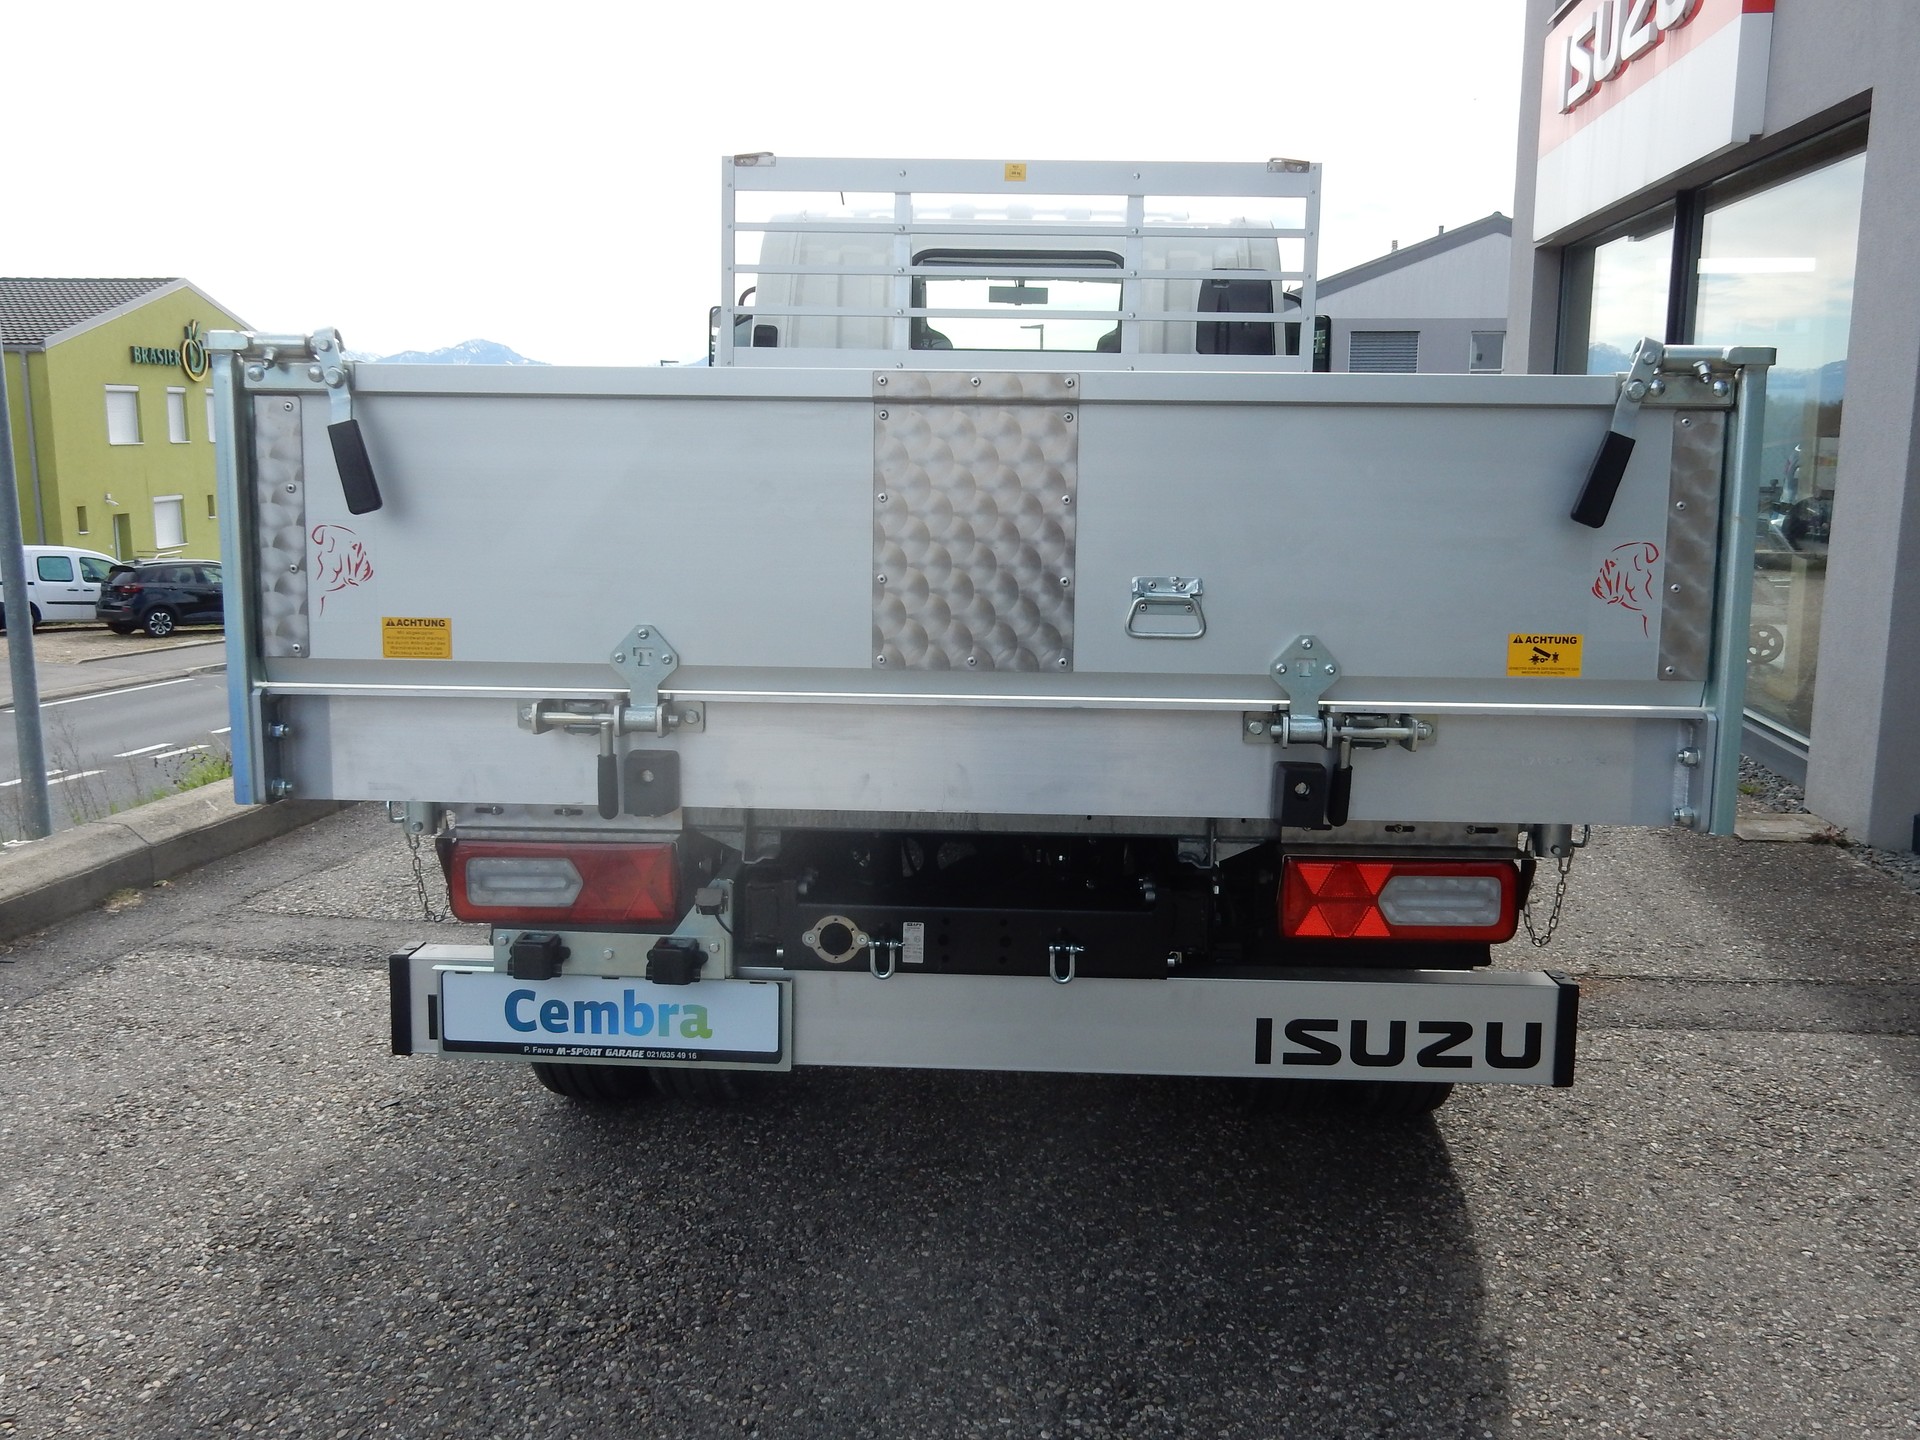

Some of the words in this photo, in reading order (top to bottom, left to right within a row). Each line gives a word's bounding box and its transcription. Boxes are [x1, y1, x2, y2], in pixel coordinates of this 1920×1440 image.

[131, 346, 182, 367] BRASIER
[396, 618, 446, 627] ACHTUNG
[1524, 635, 1577, 645] ACHTUNG
[504, 988, 713, 1040] Cembra
[1254, 1017, 1543, 1069] ISUZU
[523, 1045, 531, 1053] P.
[532, 1046, 554, 1055] Favre
[556, 1047, 602, 1057] M-SPORT
[605, 1048, 645, 1059] GARAGE
[646, 1051, 676, 1059] 021/635
[677, 1052, 687, 1060] 49
